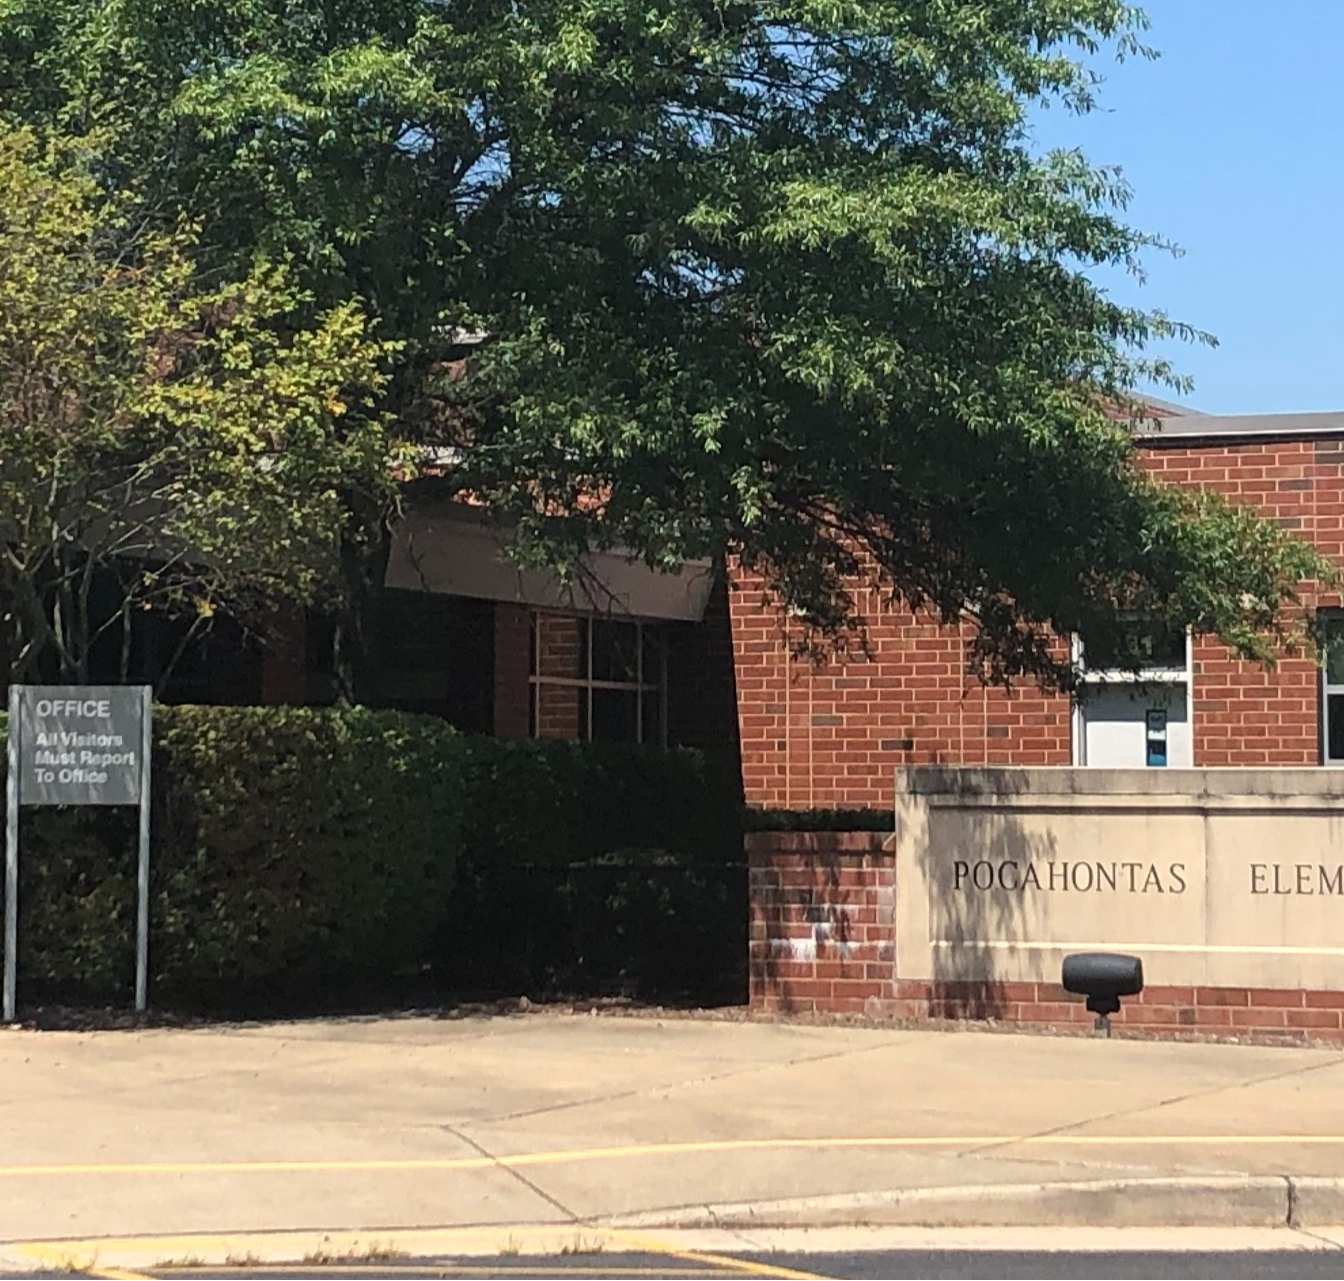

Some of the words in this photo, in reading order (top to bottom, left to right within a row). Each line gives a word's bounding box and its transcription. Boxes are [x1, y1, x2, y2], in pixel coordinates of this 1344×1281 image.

[36, 700, 111, 717] OFFICE
[35, 732, 58, 747] All
[60, 731, 123, 747] Visitors
[34, 750, 76, 765] Must
[80, 750, 135, 767] Report
[34, 768, 55, 783] To
[58, 768, 108, 784] Office
[953, 859, 1187, 894] POCAHONTAS
